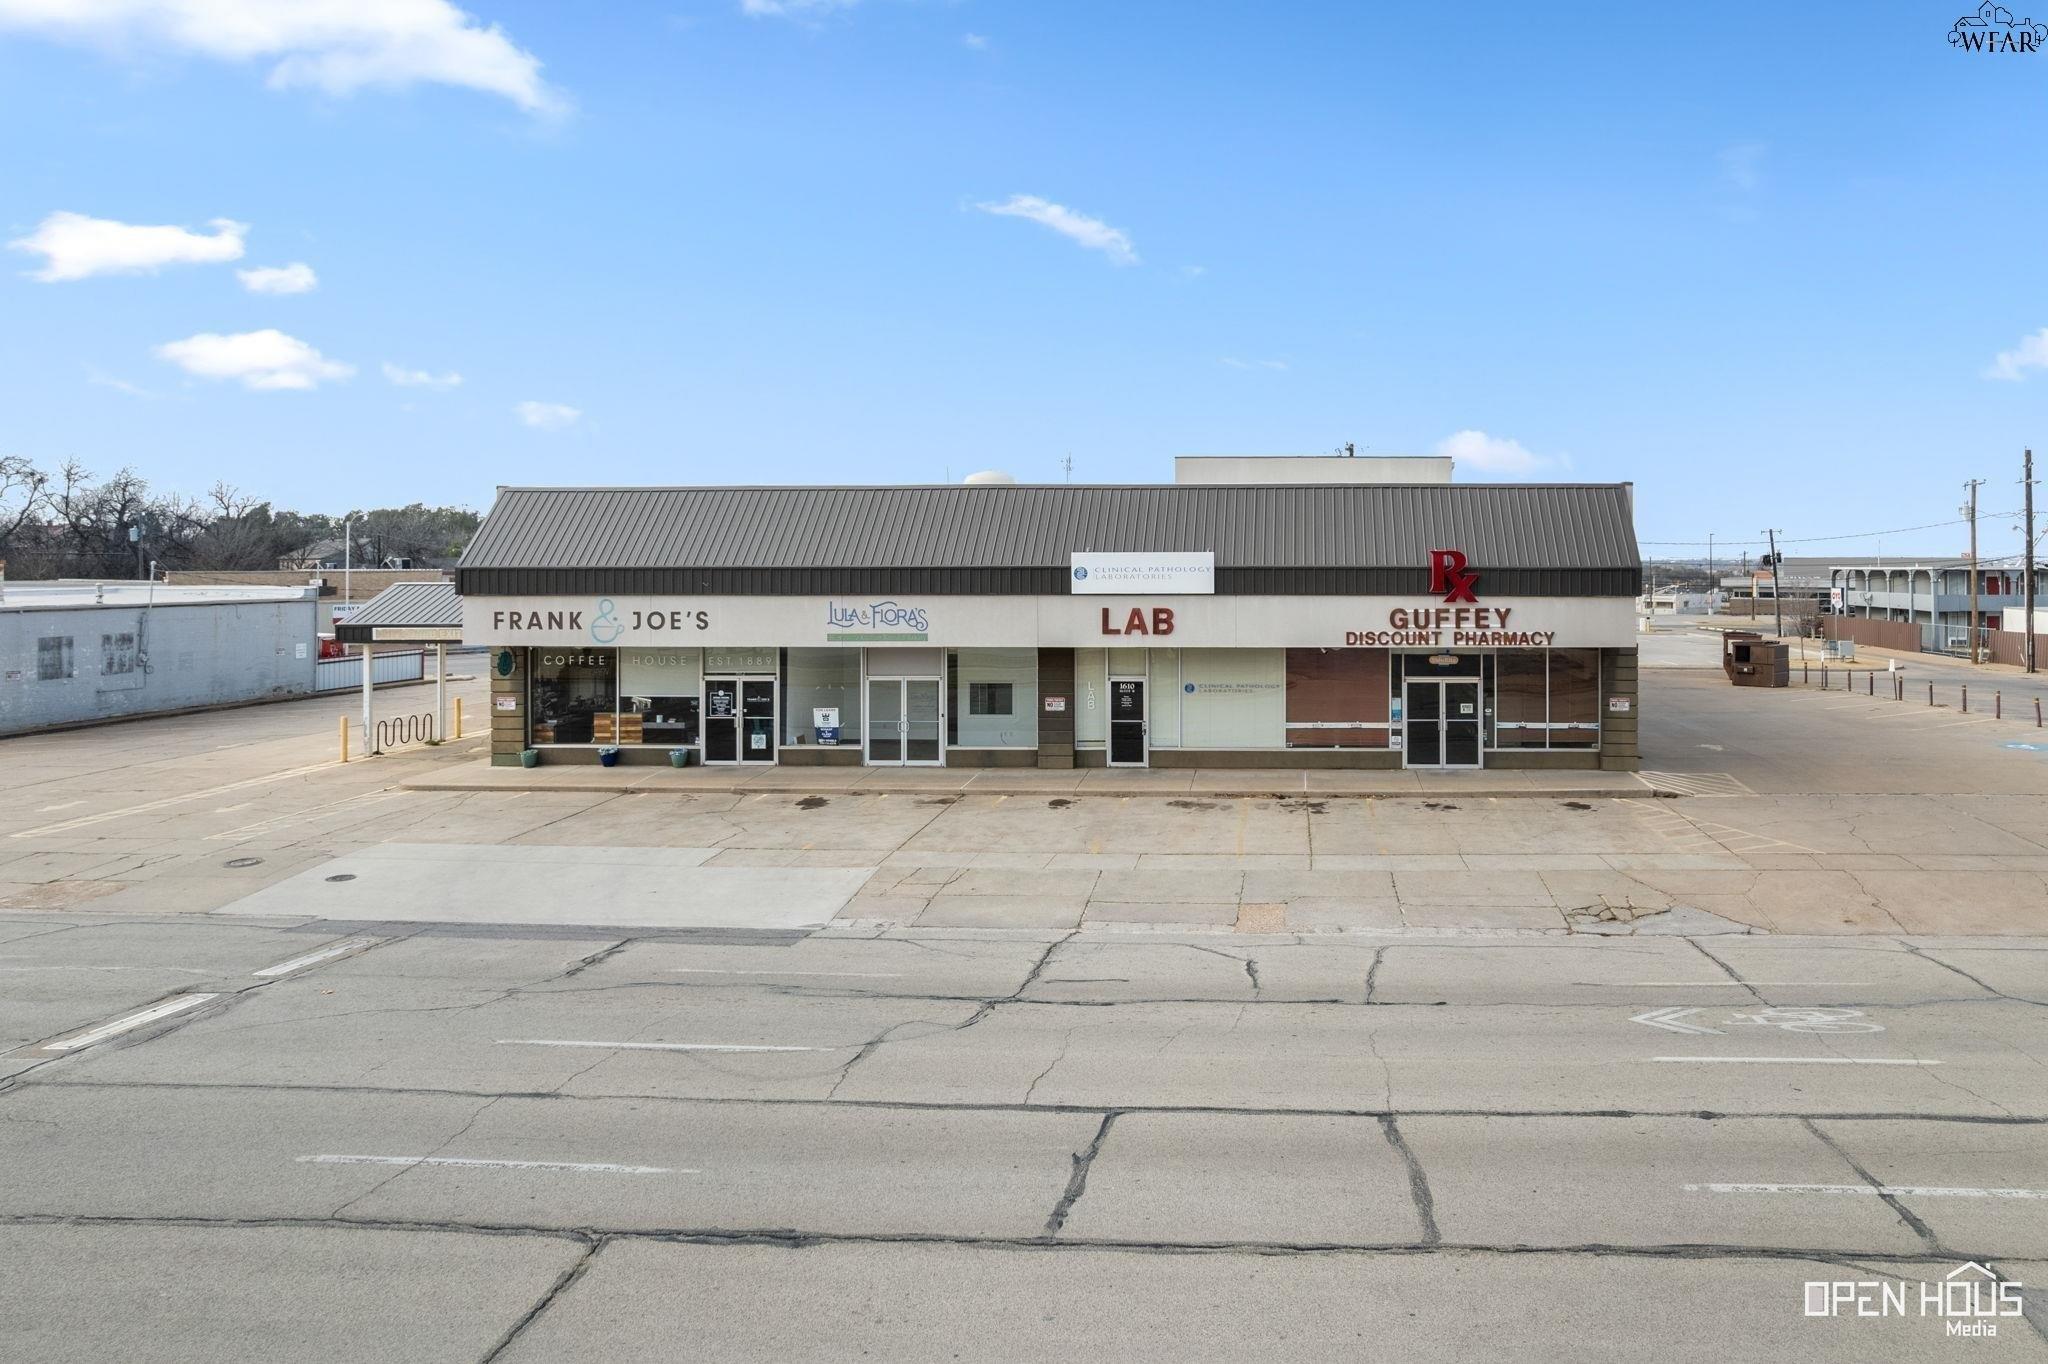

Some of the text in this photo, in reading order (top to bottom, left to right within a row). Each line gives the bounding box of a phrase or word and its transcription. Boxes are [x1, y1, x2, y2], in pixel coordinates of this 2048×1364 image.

[493, 611, 583, 630] FRANK
[632, 611, 709, 630] JOE'S
[1102, 608, 1174, 635] LAB
[1389, 608, 1511, 629] GUFFEY
[1345, 631, 1555, 646] DISCOUNT PHARMACY
[544, 655, 605, 665] COFFEE
[632, 656, 687, 665] HOUSE
